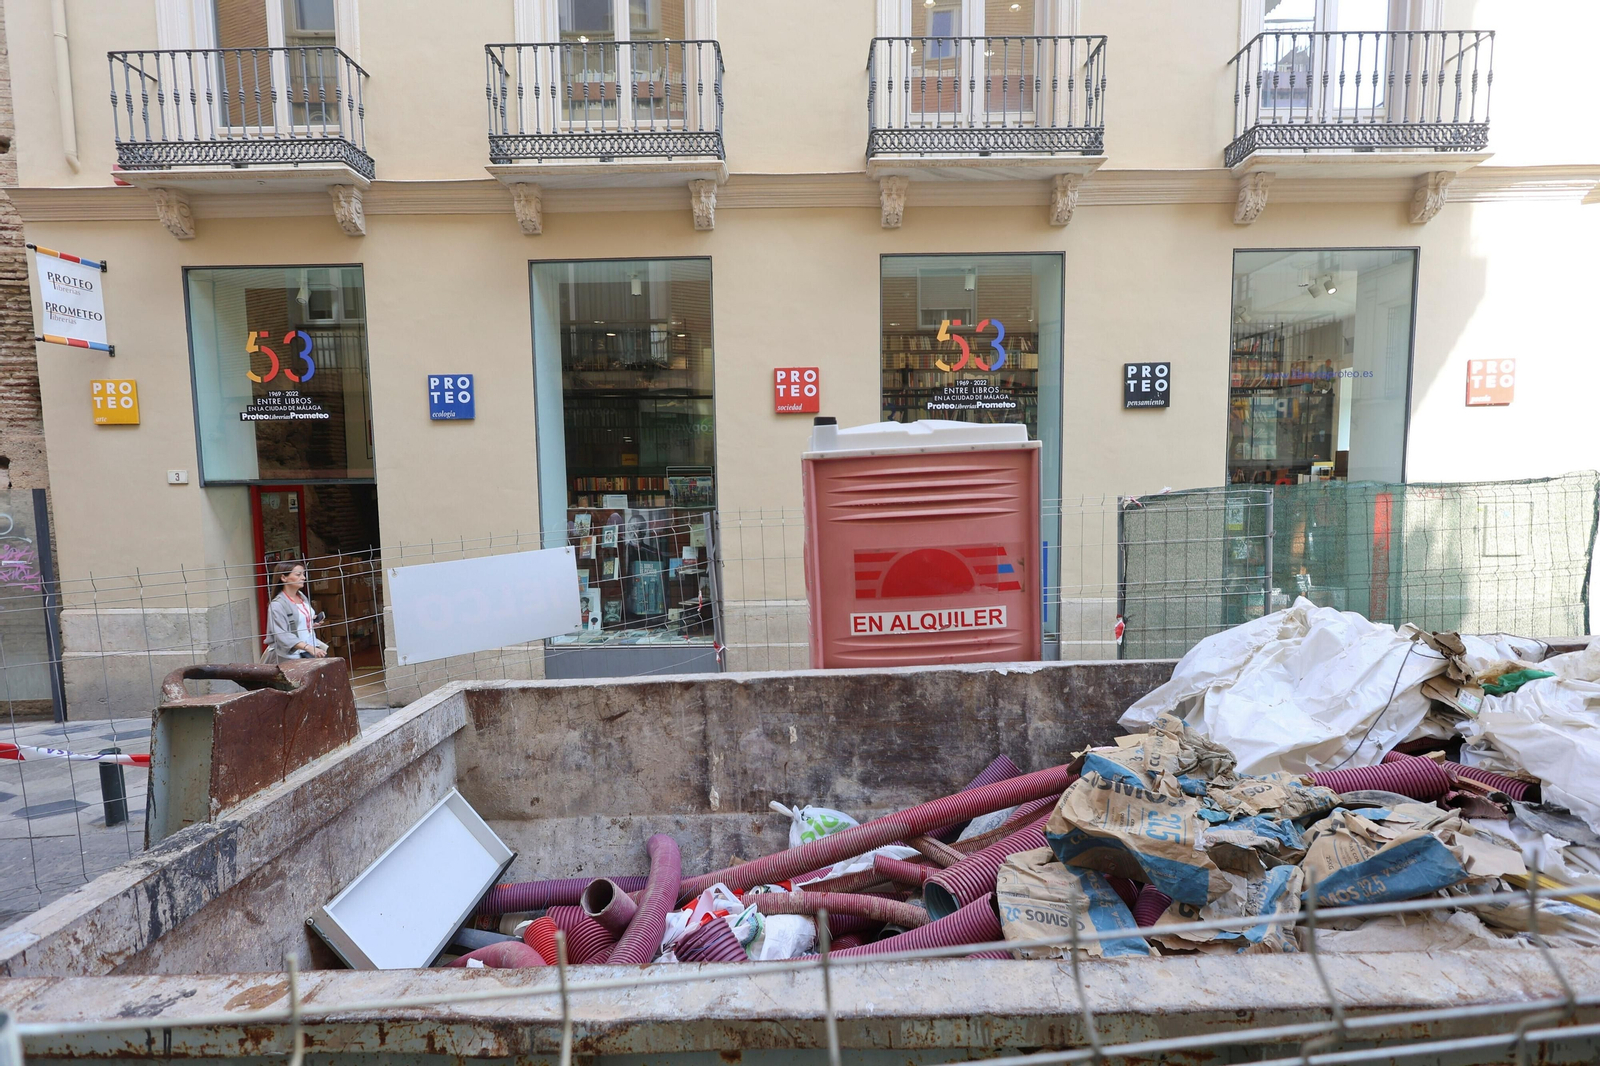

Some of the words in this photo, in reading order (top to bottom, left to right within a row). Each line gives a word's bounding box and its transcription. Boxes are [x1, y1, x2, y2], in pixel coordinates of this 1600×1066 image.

[47, 271, 93, 291] PROTEO
[45, 301, 103, 321] PROMETEO
[935, 318, 1006, 372] 53
[245, 330, 315, 383] 53
[1127, 364, 1168, 378] PRO
[1472, 359, 1515, 374] PRO
[776, 369, 817, 383] PRO
[1471, 374, 1514, 389] TEO
[92, 382, 132, 395] PRO
[429, 376, 470, 390] PRO
[1127, 379, 1168, 392] TEO
[776, 384, 817, 397] TEO
[972, 386, 1000, 394] LIBROS
[93, 396, 134, 409] TEO
[284, 397, 312, 405] LIBROS
[430, 391, 471, 404] TEO
[1126, 398, 1165, 408] pensamiento
[777, 403, 803, 411] sociedad
[927, 402, 955, 410] Proteo
[976, 401, 1016, 409] Prometeo
[241, 412, 270, 420] Proteo
[290, 411, 329, 420] Prometeo
[432, 410, 456, 419] ecología
[174, 472, 180, 481] 3
[853, 615, 883, 633] EN
[890, 608, 1004, 632] ALQUILER
